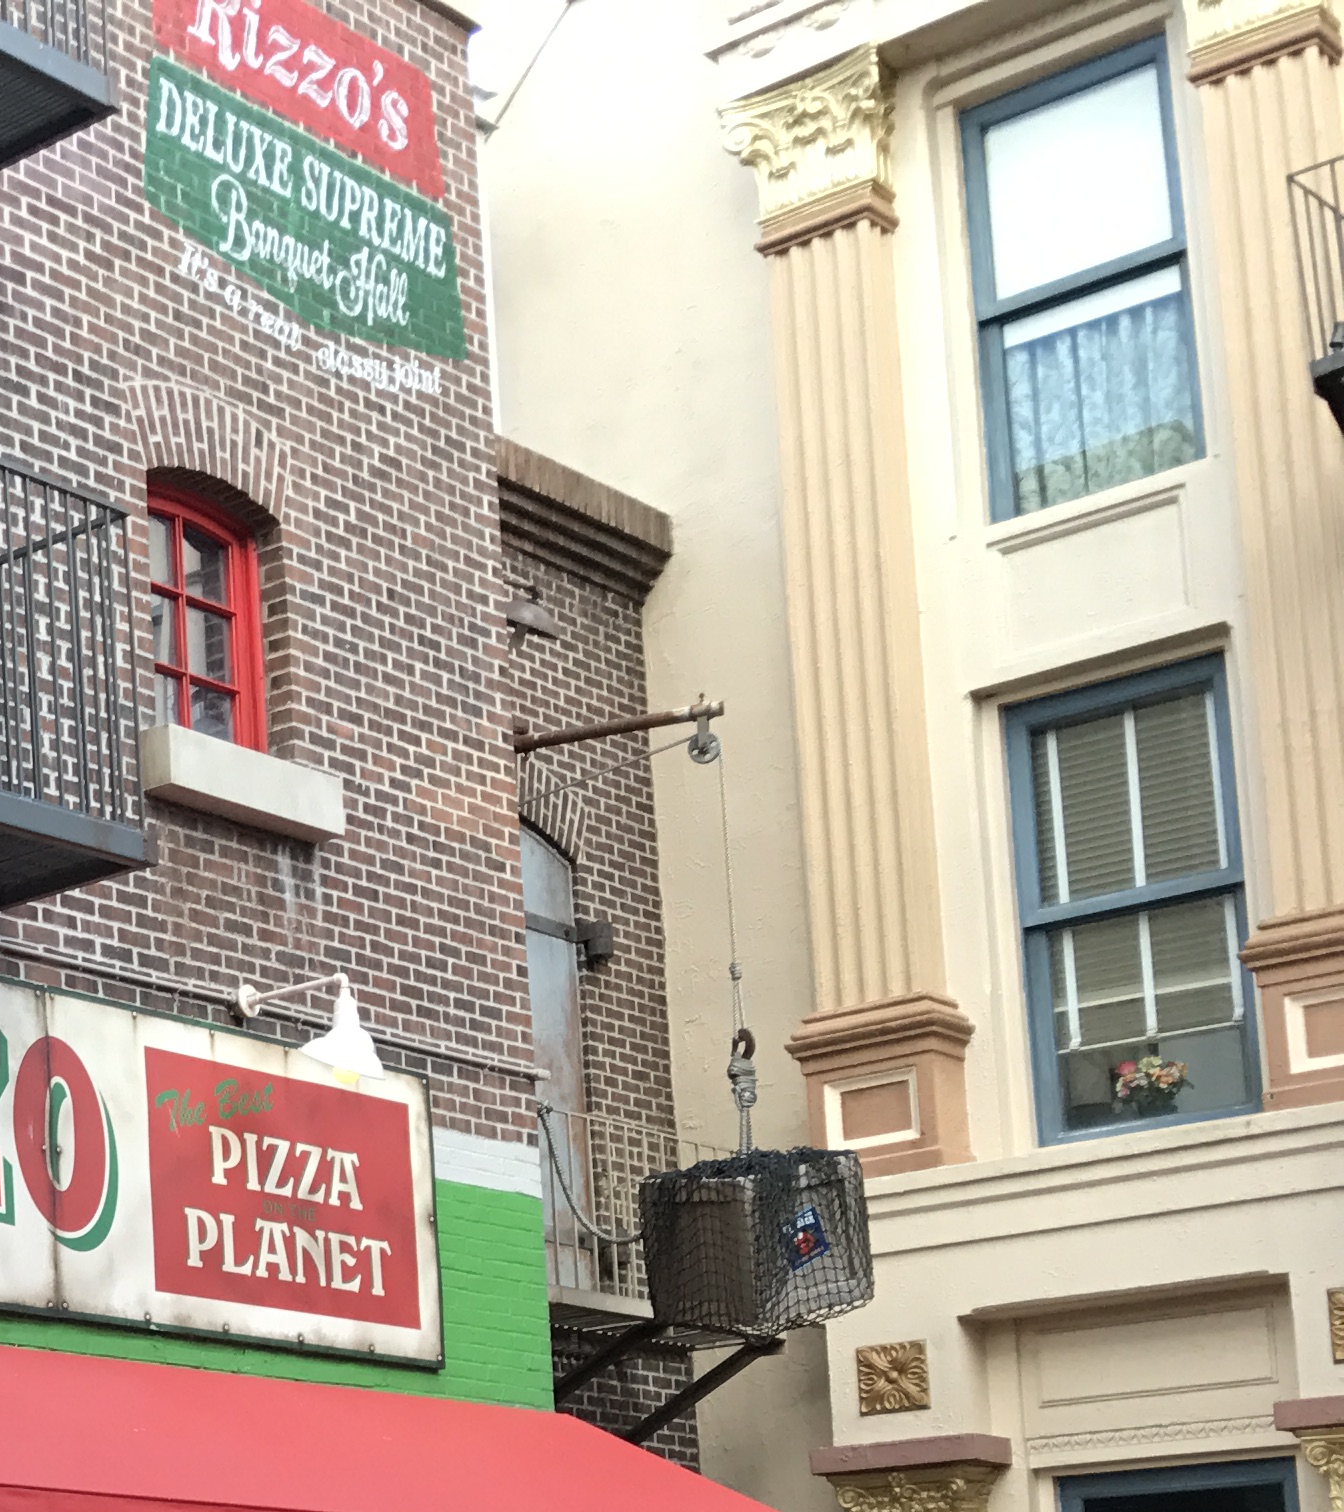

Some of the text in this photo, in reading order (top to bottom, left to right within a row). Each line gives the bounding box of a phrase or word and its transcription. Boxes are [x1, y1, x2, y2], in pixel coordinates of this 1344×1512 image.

[156, 77, 448, 280] DELUXE SUPREME
[211, 174, 411, 327] Banquet Hall
[178, 242, 443, 394] It's a real classy joint
[155, 1078, 274, 1132] The Best
[209, 1125, 364, 1211] PIZZA
[263, 1200, 317, 1223] ON THE
[184, 1206, 392, 1297] PLANET
